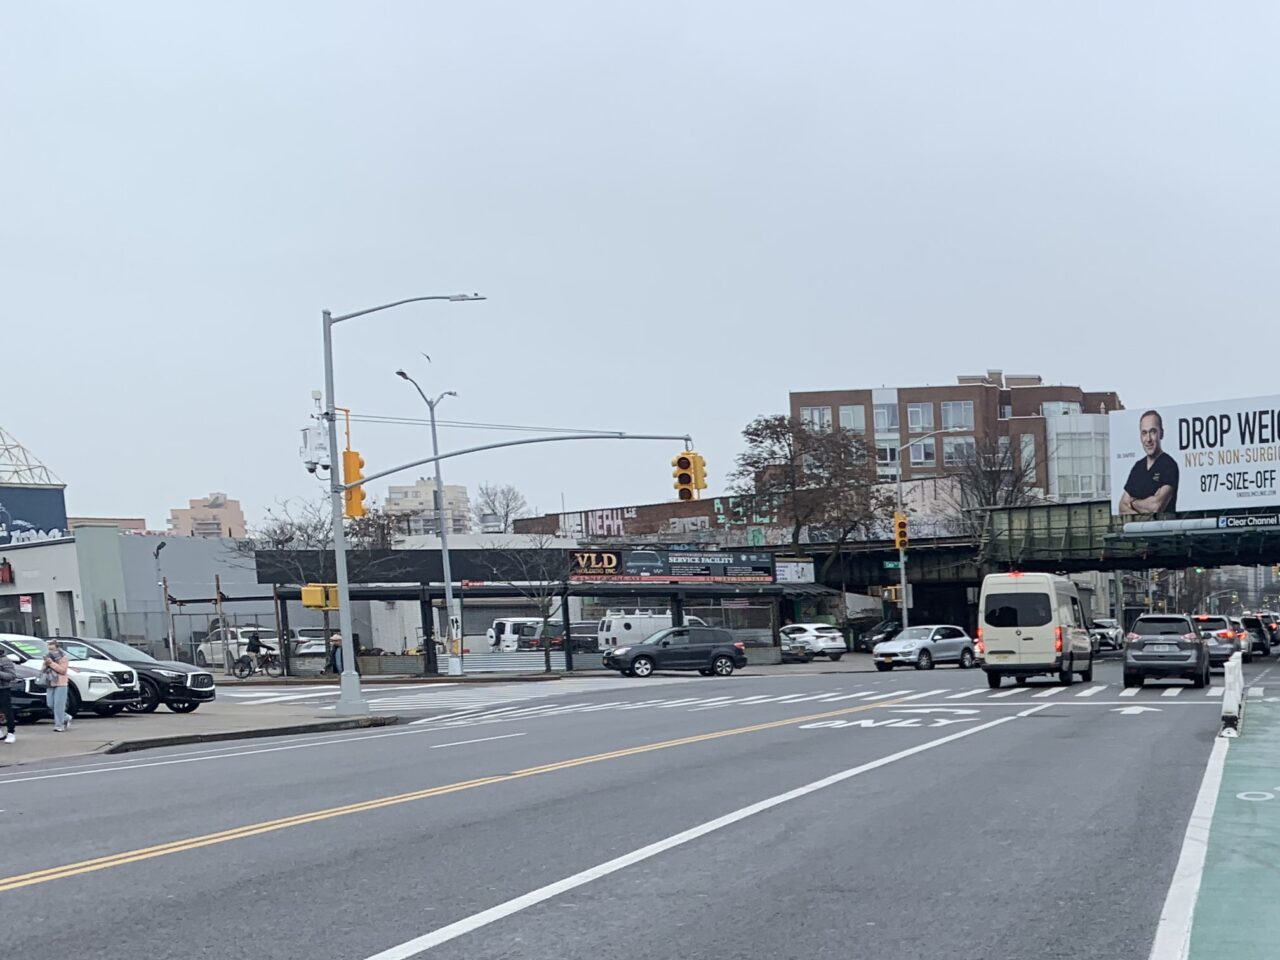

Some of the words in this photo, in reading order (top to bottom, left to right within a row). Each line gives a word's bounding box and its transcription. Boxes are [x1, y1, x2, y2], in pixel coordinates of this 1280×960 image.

[1178, 413, 1231, 451] DROP
[1184, 451, 1215, 468] NYC'S
[1200, 470, 1277, 493] 877-SIZE-OFF
[1227, 516, 1246, 527] Clear
[1247, 515, 1278, 526] Channel
[574, 553, 617, 568] VLD
[798, 718, 981, 728] ONLY
